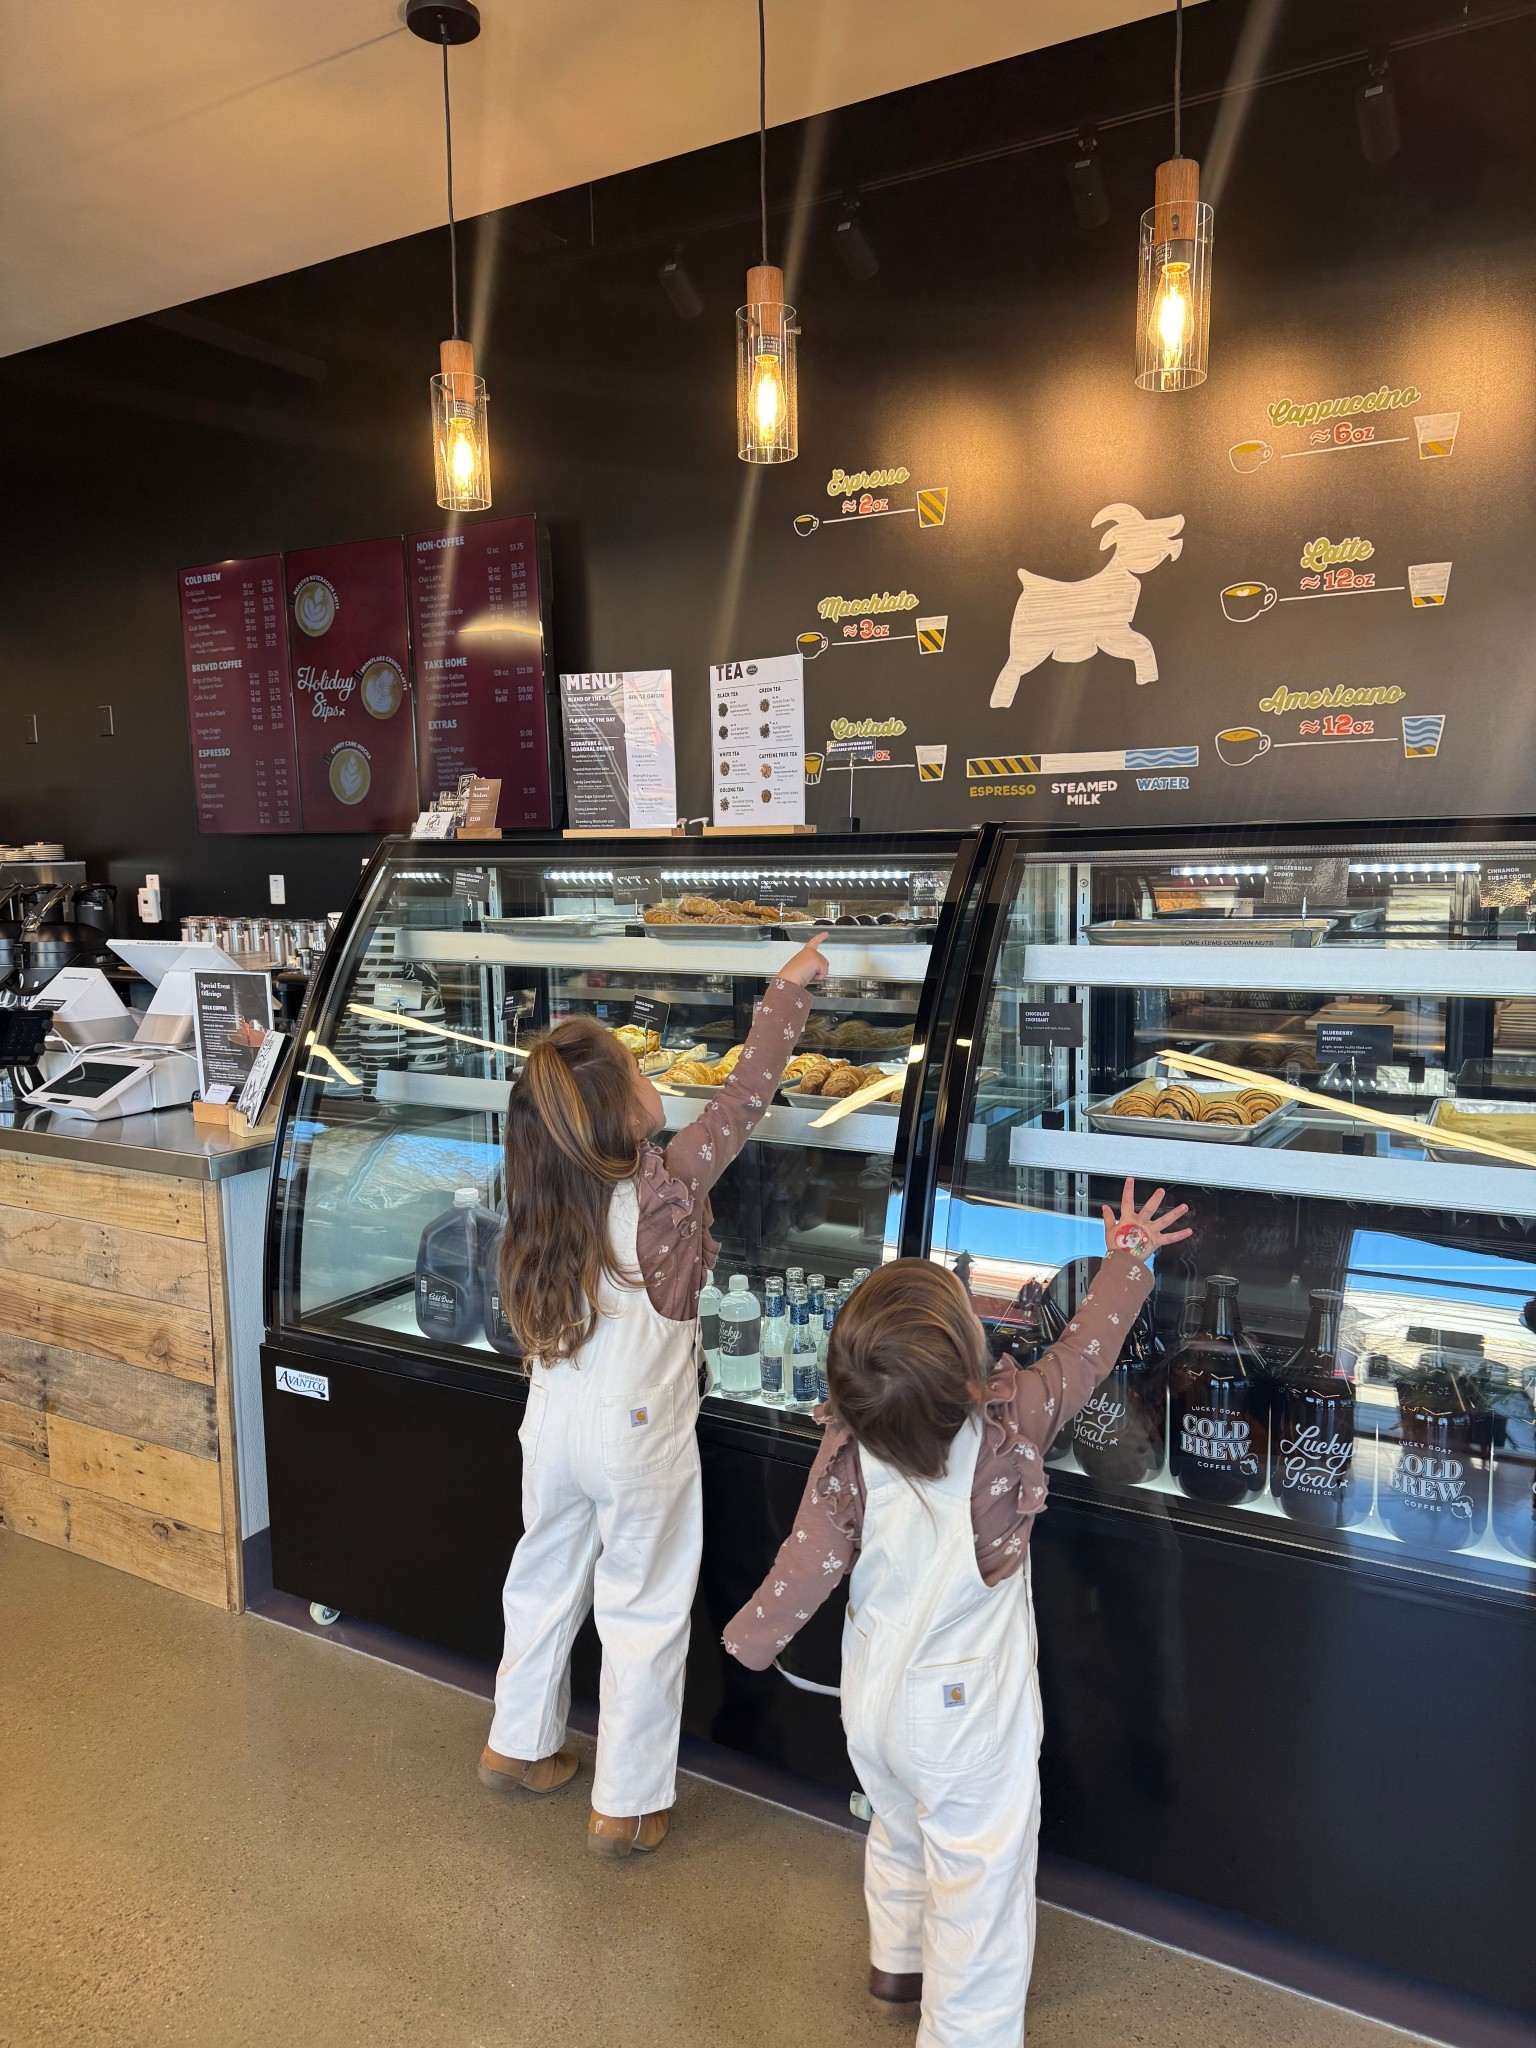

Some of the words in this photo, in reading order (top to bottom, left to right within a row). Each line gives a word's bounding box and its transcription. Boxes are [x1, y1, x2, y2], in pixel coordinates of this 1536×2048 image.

[1267, 384, 1421, 428] Cappuccino
[827, 465, 910, 497] Espresso
[417, 536, 464, 552] NON-COFFEE
[1300, 535, 1375, 572] Latte
[185, 574, 202, 585] COLD
[203, 573, 221, 583] BREW
[817, 590, 919, 622] Macchiato
[192, 662, 217, 672] BREWED
[219, 660, 242, 669] COFFEE
[424, 659, 444, 670] TAKE
[444, 657, 467, 668] HOME
[716, 663, 743, 681] TEA
[297, 666, 356, 701] Holiday
[566, 673, 617, 690] MENU
[312, 692, 339, 723] Sips
[1259, 684, 1406, 714] Americano
[428, 719, 457, 730] EXTRAS
[830, 717, 908, 740] Cortado
[199, 748, 230, 758] ESPRESSO
[969, 783, 1037, 798] ESPRESSO
[1050, 780, 1118, 794] STEAMED
[1136, 774, 1190, 791] WATER
[1066, 791, 1101, 806] MILK
[201, 990, 222, 998] Offerings
[278, 1371, 326, 1391] AVANTCO
[1220, 1409, 1240, 1417] GOAT
[1183, 1414, 1250, 1441] COLD
[1079, 1438, 1095, 1449] COFFEE
[1180, 1431, 1252, 1461] BREW
[1280, 1423, 1357, 1470] Lucky
[1428, 1445, 1452, 1455] GOAT
[1197, 1461, 1232, 1471] COFFEE
[1282, 1456, 1346, 1489] Goat
[1391, 1450, 1464, 1480] COLD
[1297, 1486, 1320, 1495] COFFEE
[1388, 1467, 1465, 1502] BREW
[1405, 1499, 1442, 1512] COFFEE
